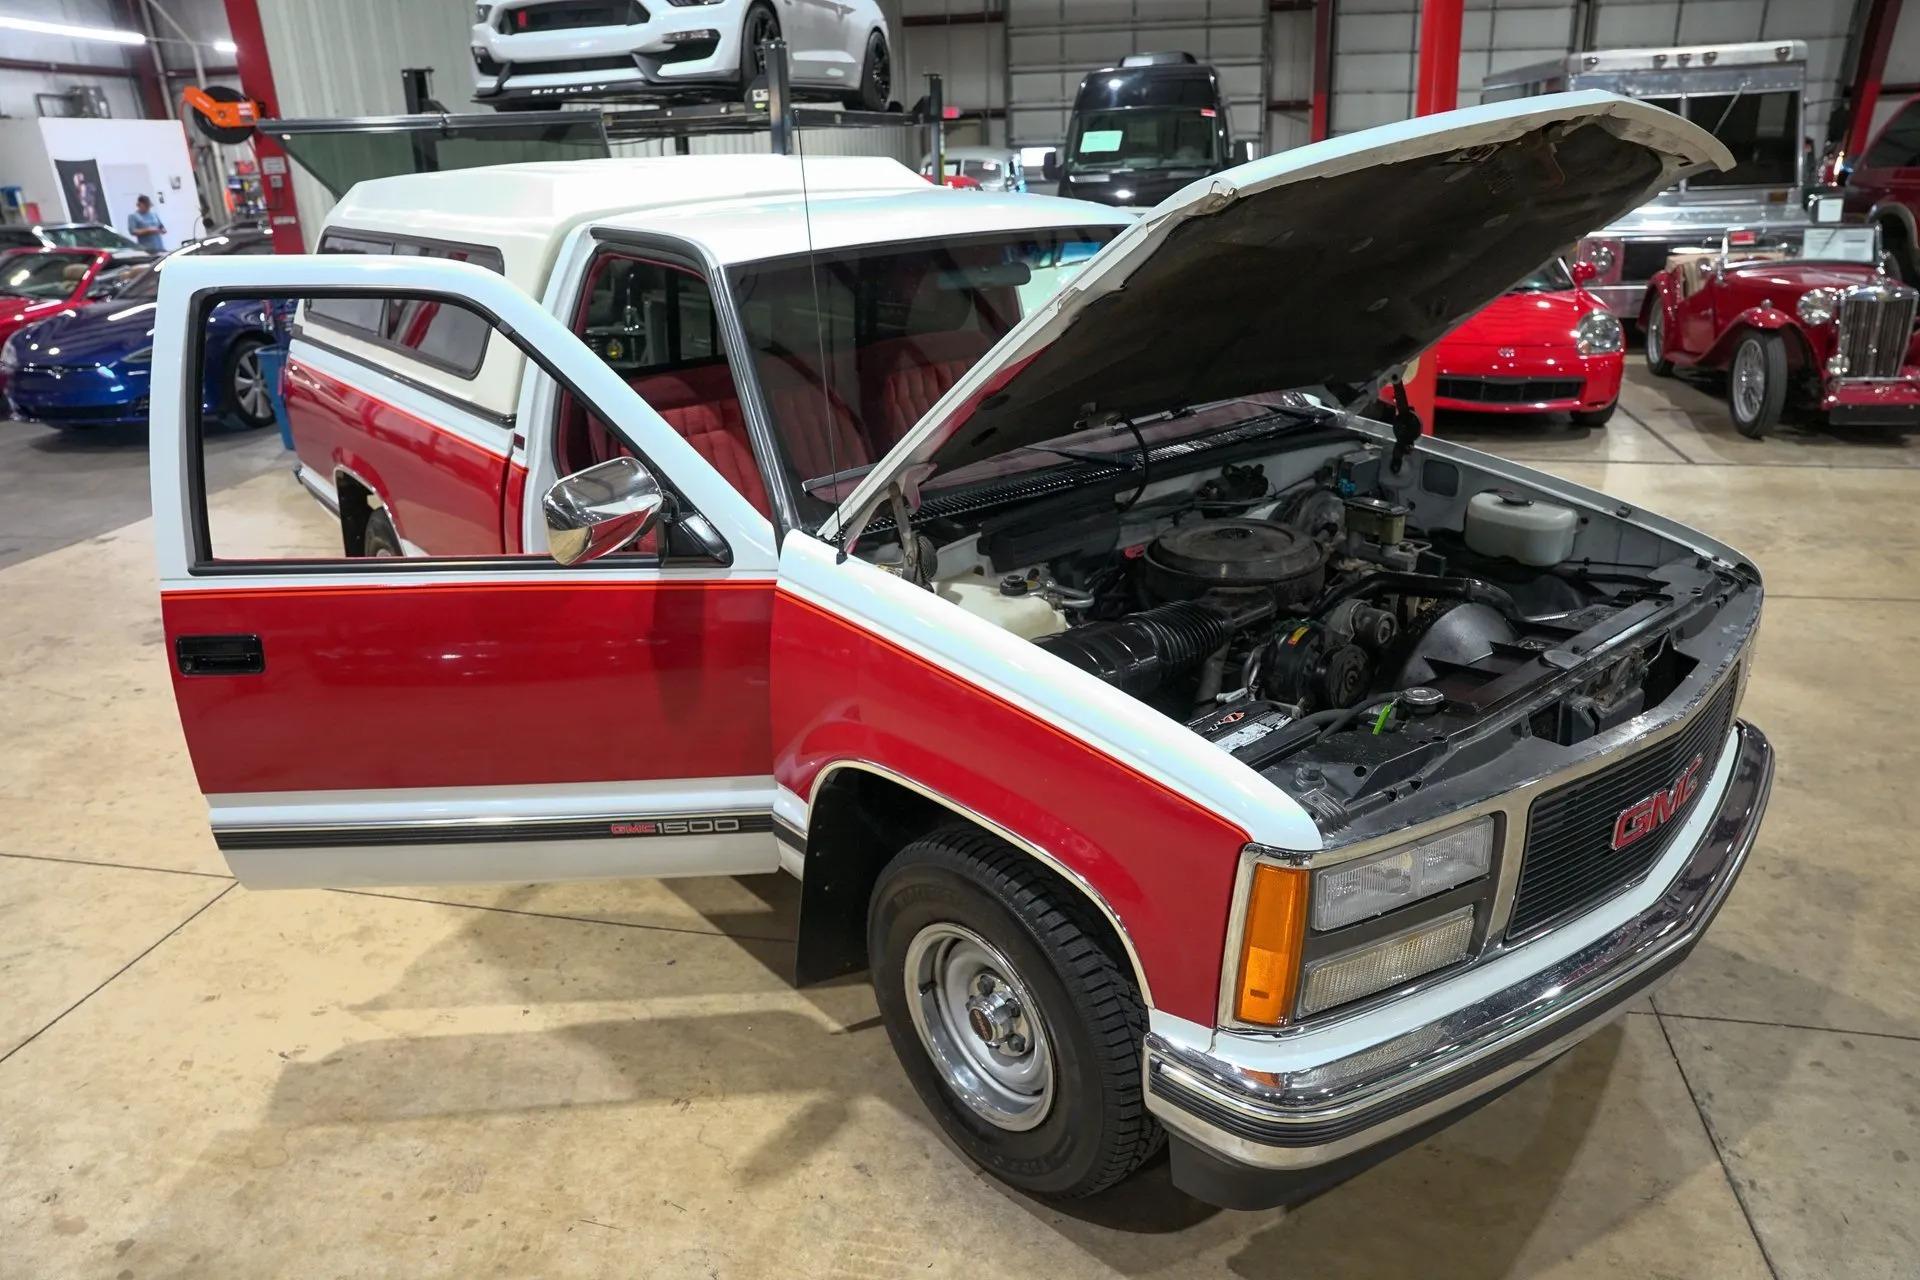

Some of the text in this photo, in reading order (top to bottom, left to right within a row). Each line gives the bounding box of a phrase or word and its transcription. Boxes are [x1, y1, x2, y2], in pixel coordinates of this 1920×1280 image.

[610, 819, 740, 834] GMC 1500
[1611, 752, 1703, 851] GMC
